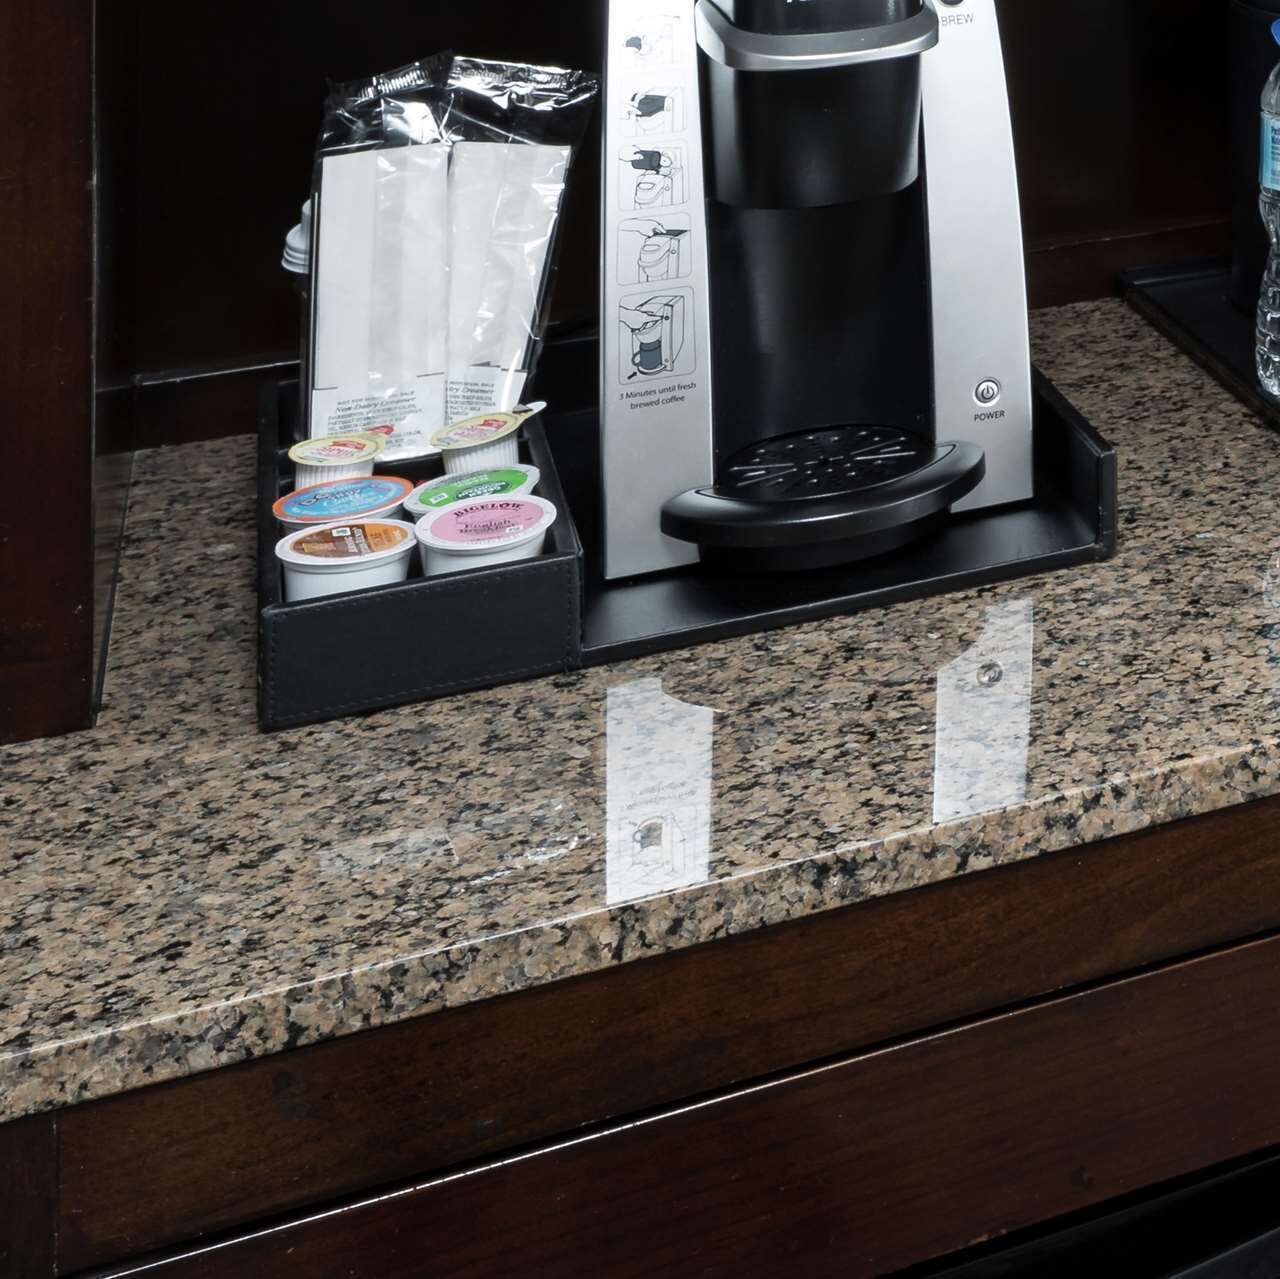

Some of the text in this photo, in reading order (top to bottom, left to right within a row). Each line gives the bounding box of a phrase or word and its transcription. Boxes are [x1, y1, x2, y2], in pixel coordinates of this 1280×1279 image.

[941, 13, 974, 26] BREW
[625, 389, 656, 399] Minutes
[658, 384, 676, 394] until
[677, 381, 697, 391] fresh
[630, 395, 685, 409] brewed coffee
[974, 410, 1005, 422] POWER
[453, 502, 525, 518] BIGELOW
